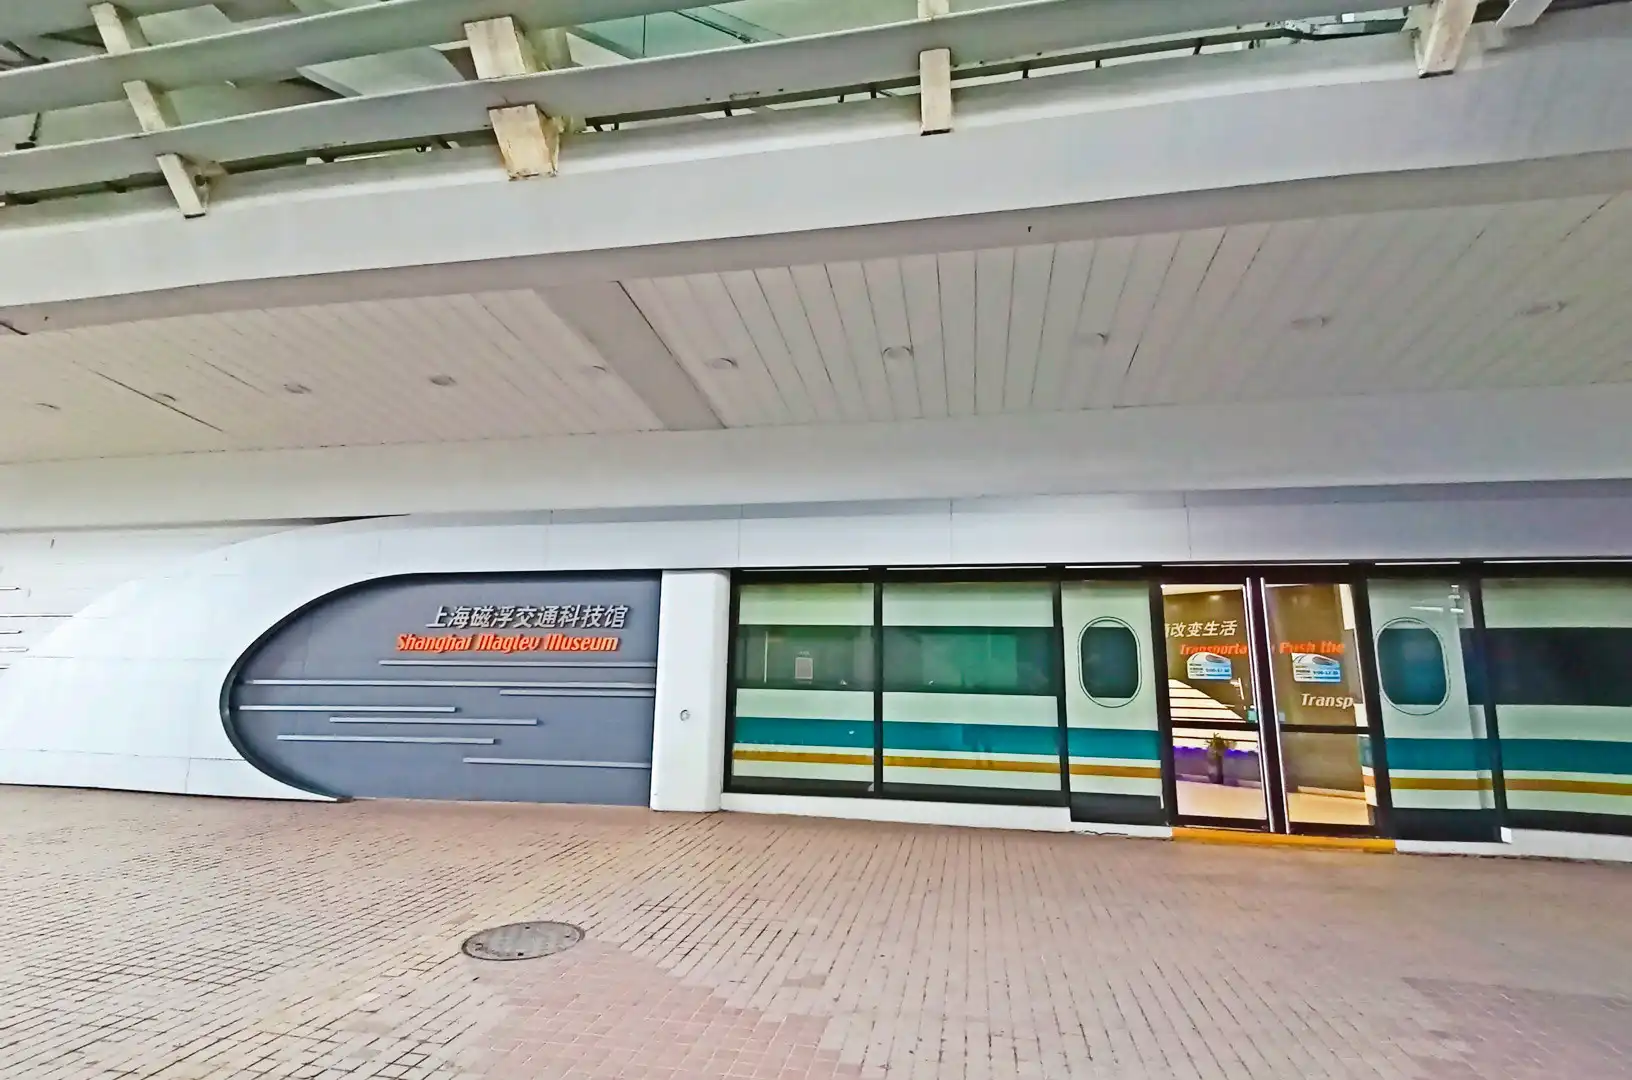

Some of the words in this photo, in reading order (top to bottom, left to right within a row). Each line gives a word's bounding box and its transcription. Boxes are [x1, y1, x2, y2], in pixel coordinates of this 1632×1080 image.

[426, 604, 629, 629] 上海磁浮交通科技馆
[396, 632, 473, 654] Shanghai
[475, 634, 540, 655] Maglev
[544, 634, 620, 653] Museum
[1319, 640, 1345, 654] the
